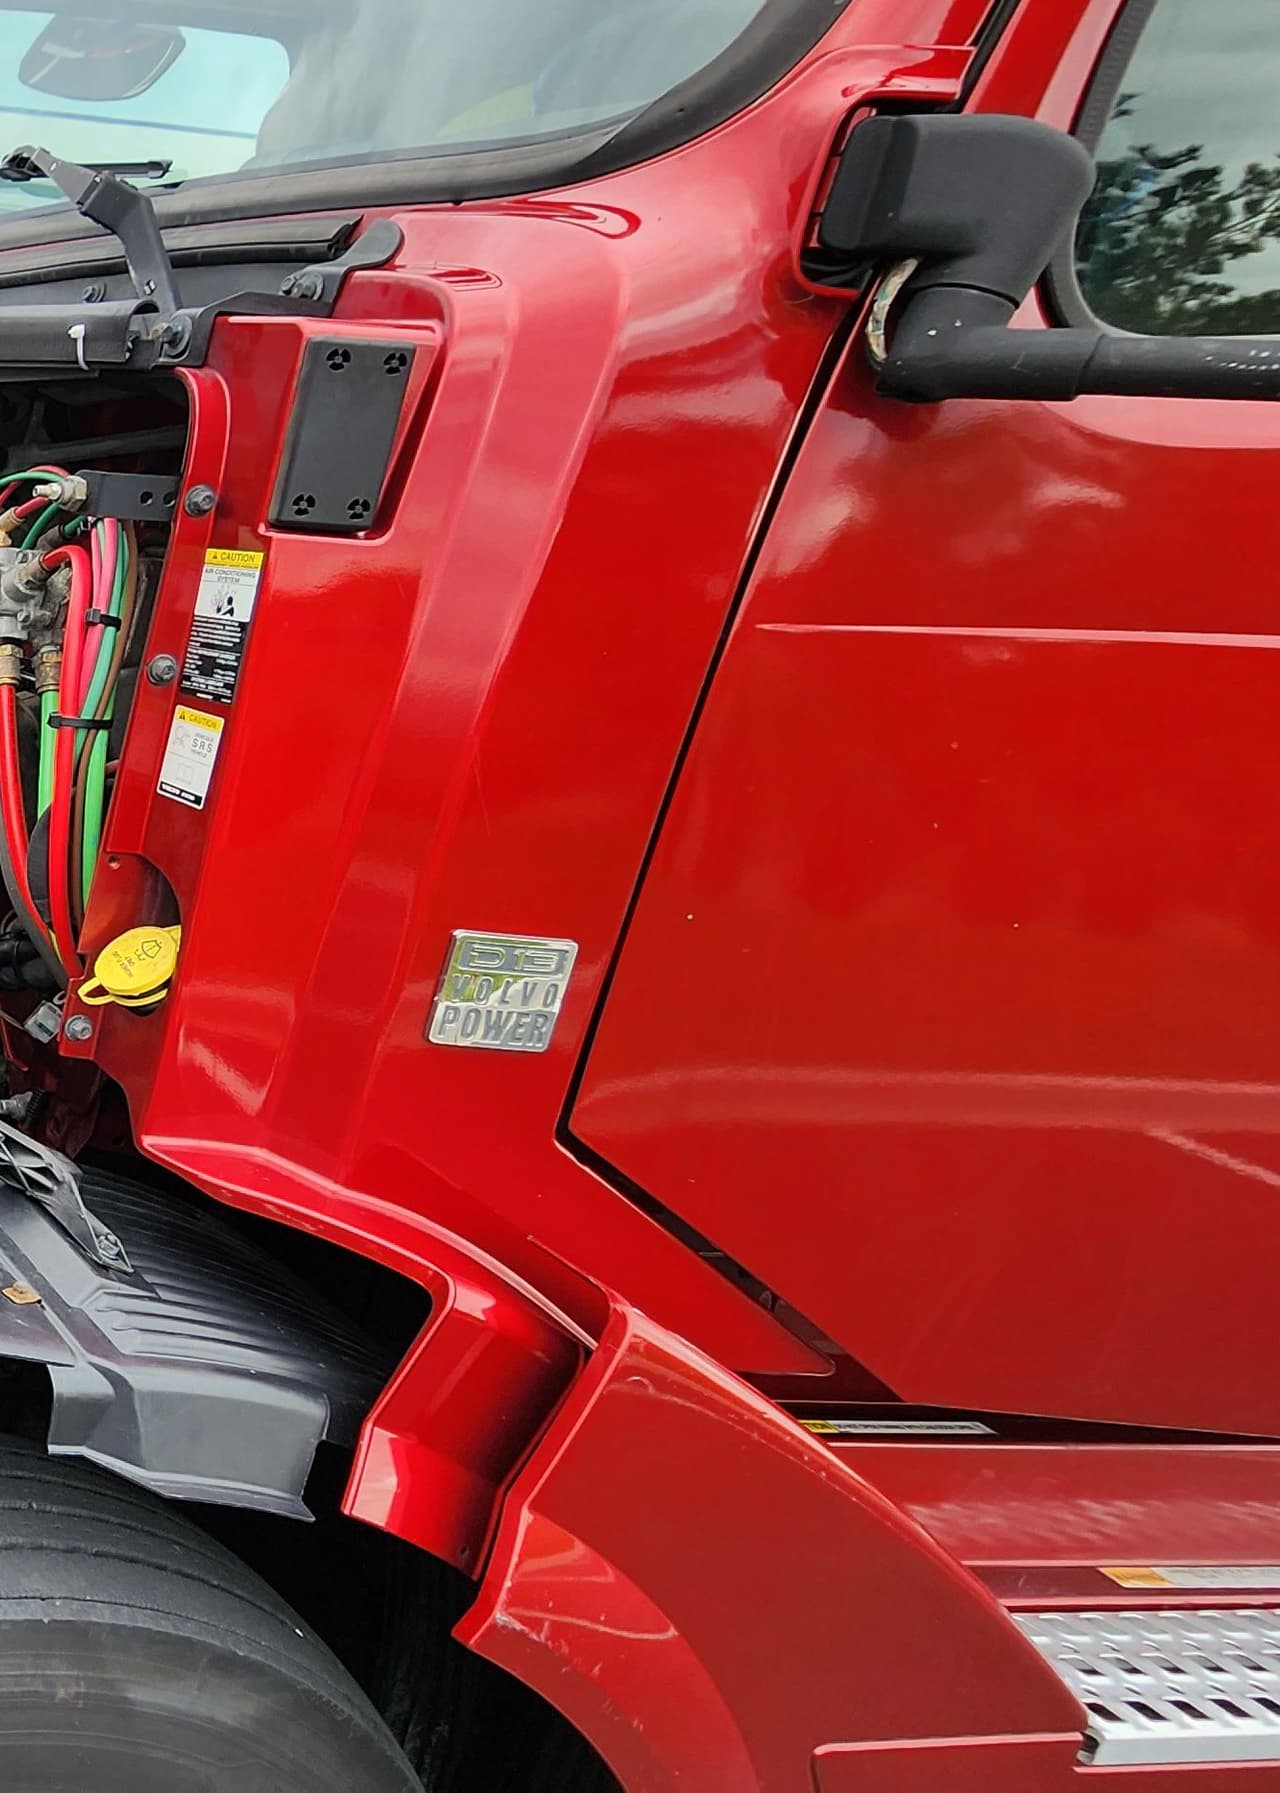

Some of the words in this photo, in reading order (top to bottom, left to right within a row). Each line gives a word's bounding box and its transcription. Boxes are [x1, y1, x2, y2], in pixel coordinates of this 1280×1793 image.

[220, 551, 256, 563] CAUTION
[189, 714, 217, 729] CAUTION
[452, 973, 560, 1009] VOLVO
[438, 1005, 550, 1046] POWER
